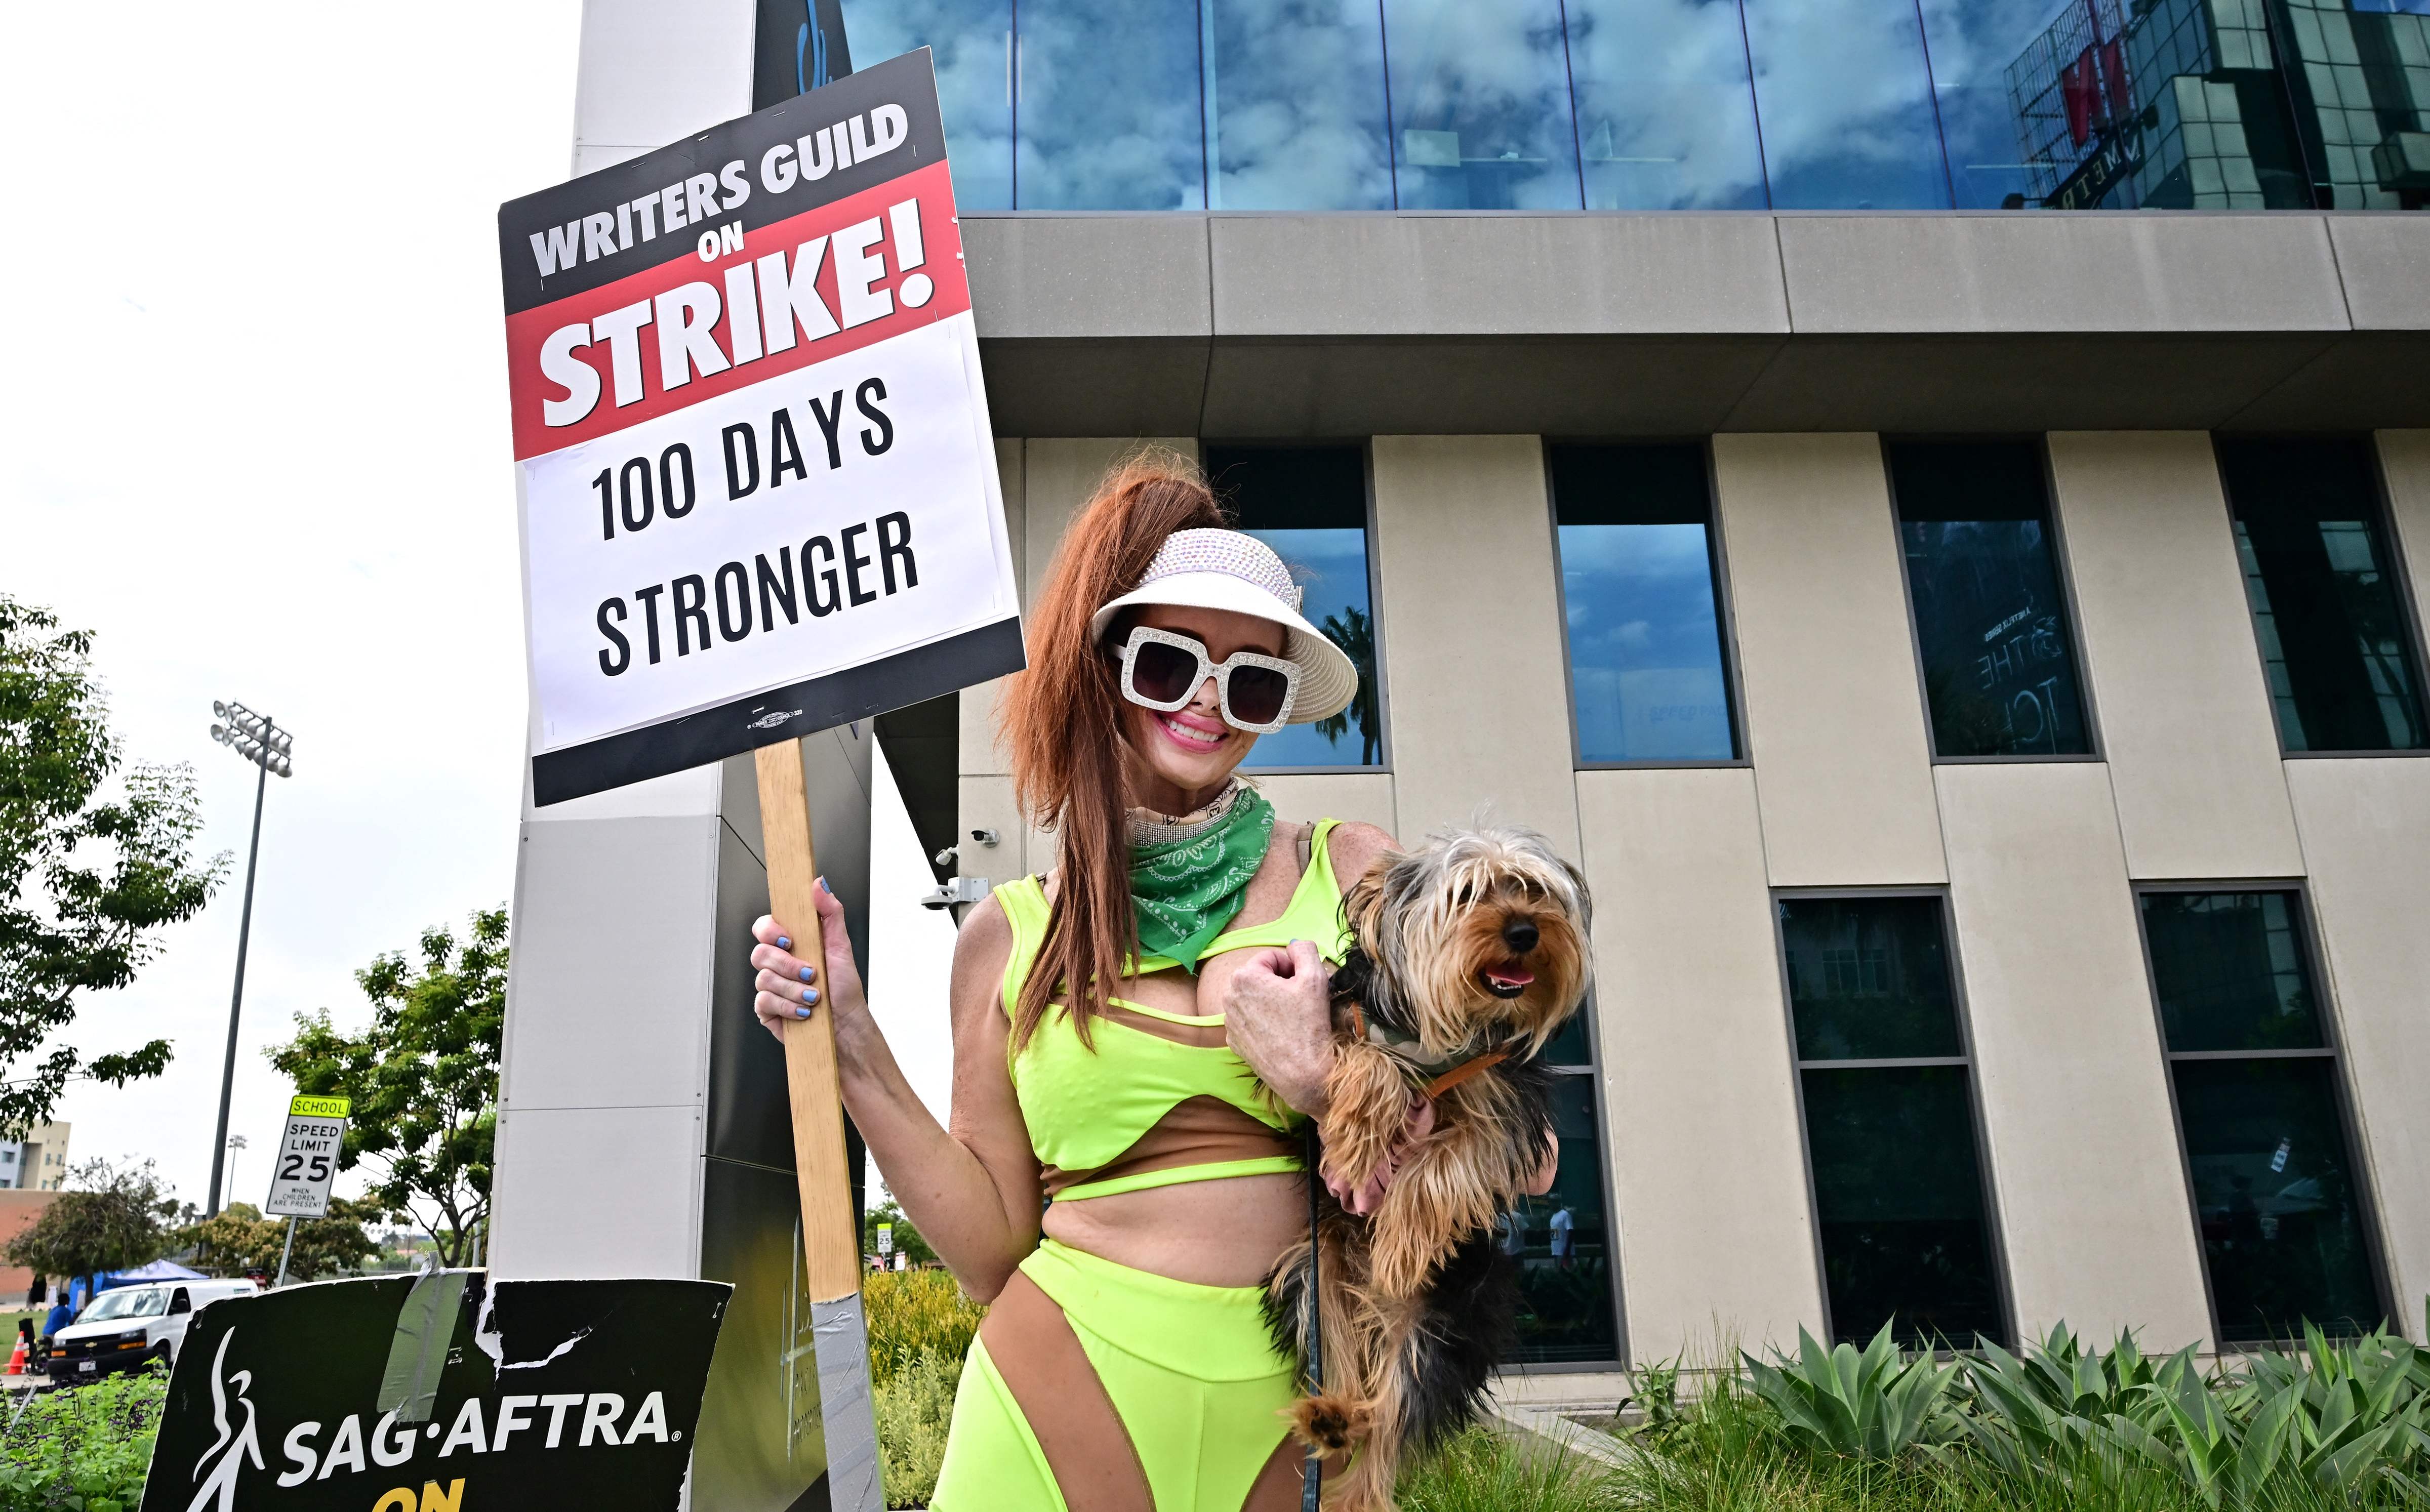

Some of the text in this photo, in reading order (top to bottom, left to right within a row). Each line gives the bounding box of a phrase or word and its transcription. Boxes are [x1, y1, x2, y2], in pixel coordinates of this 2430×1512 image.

[529, 103, 909, 277] WRITERS GUILD
[697, 220, 744, 263] ON
[539, 197, 934, 428] STRIKE!
[592, 377, 894, 541] 100 DAYS
[597, 510, 919, 677] STRONGER
[294, 1101, 344, 1114] SCHOOL
[290, 1124, 338, 1137] SPEED
[291, 1140, 330, 1152] LIMIT
[279, 1154, 330, 1182] 25
